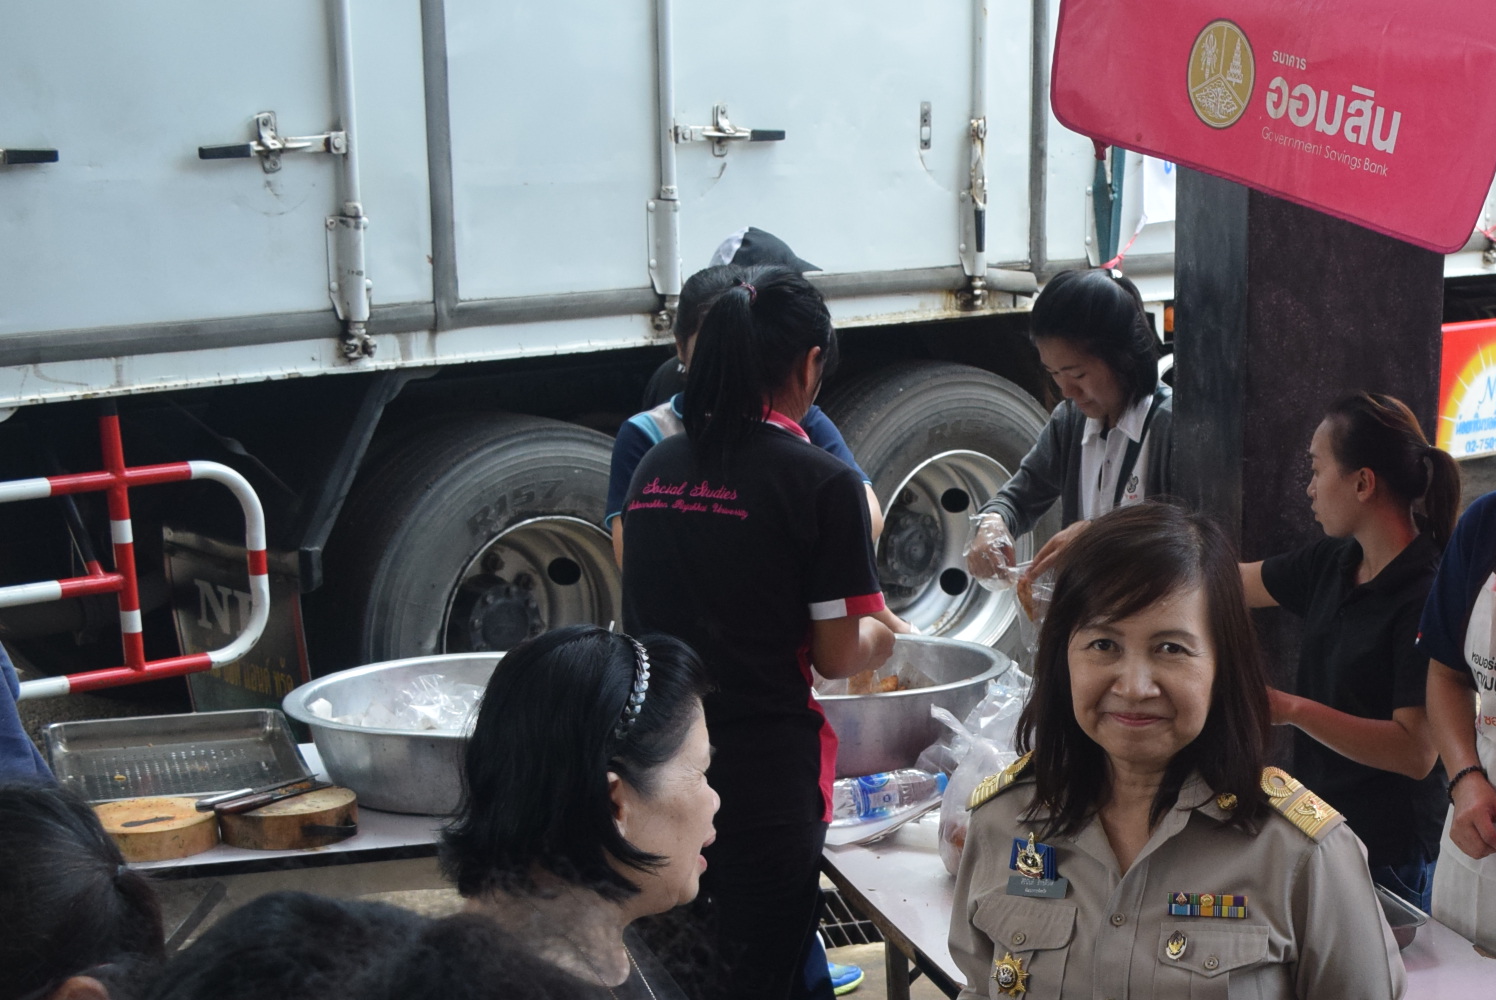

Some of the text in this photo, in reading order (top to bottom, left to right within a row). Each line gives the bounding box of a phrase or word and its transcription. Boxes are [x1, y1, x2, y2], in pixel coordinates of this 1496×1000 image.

[1272, 50, 1307, 70] ธนาคาร
[1266, 76, 1402, 154] ออมสิน
[1262, 126, 1389, 177] Government Savings Bank
[642, 476, 738, 500] Social Studies
